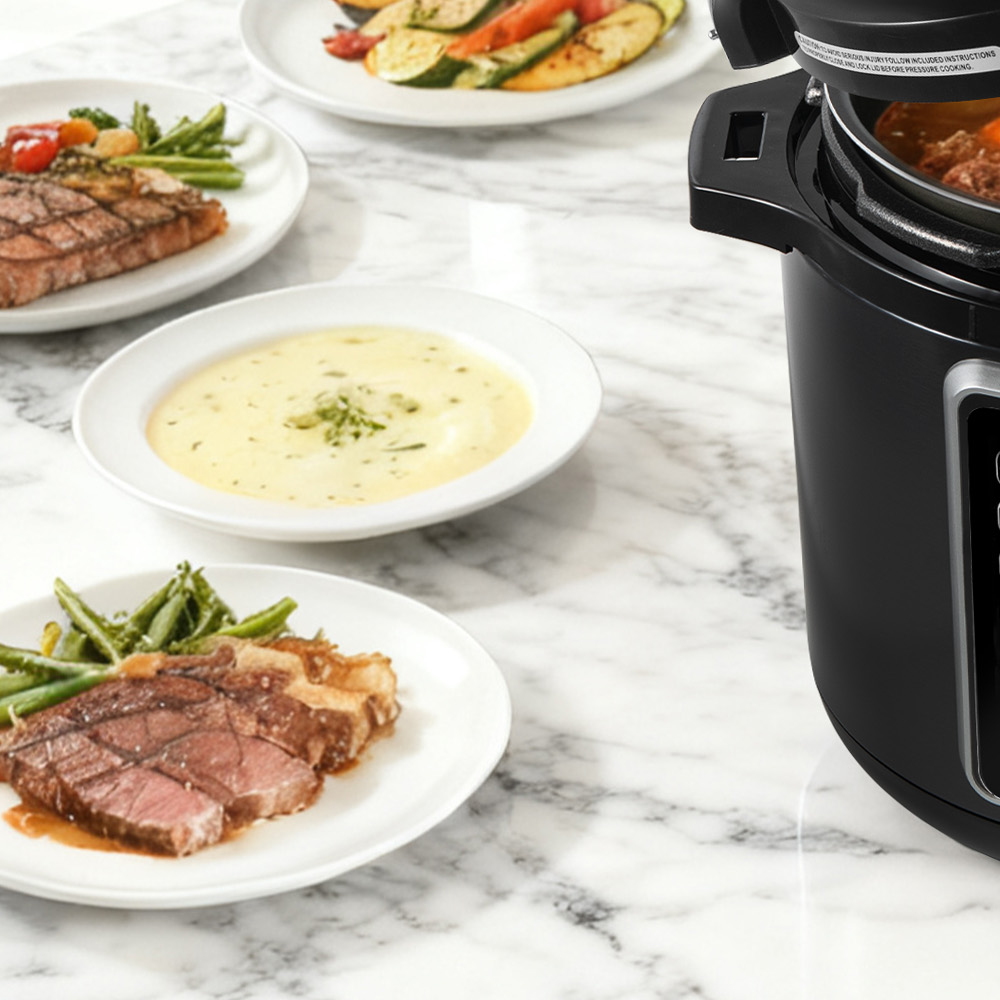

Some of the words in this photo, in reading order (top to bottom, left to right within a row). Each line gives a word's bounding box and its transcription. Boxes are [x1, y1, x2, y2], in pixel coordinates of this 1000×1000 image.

[864, 55, 885, 63] INJURY
[885, 56, 910, 64] FOLLOW
[910, 56, 943, 64] INCLUDED
[944, 50, 996, 63] INSTRUCTIONS
[881, 65, 905, 73] BEFORE
[940, 63, 974, 72] COOKING.
